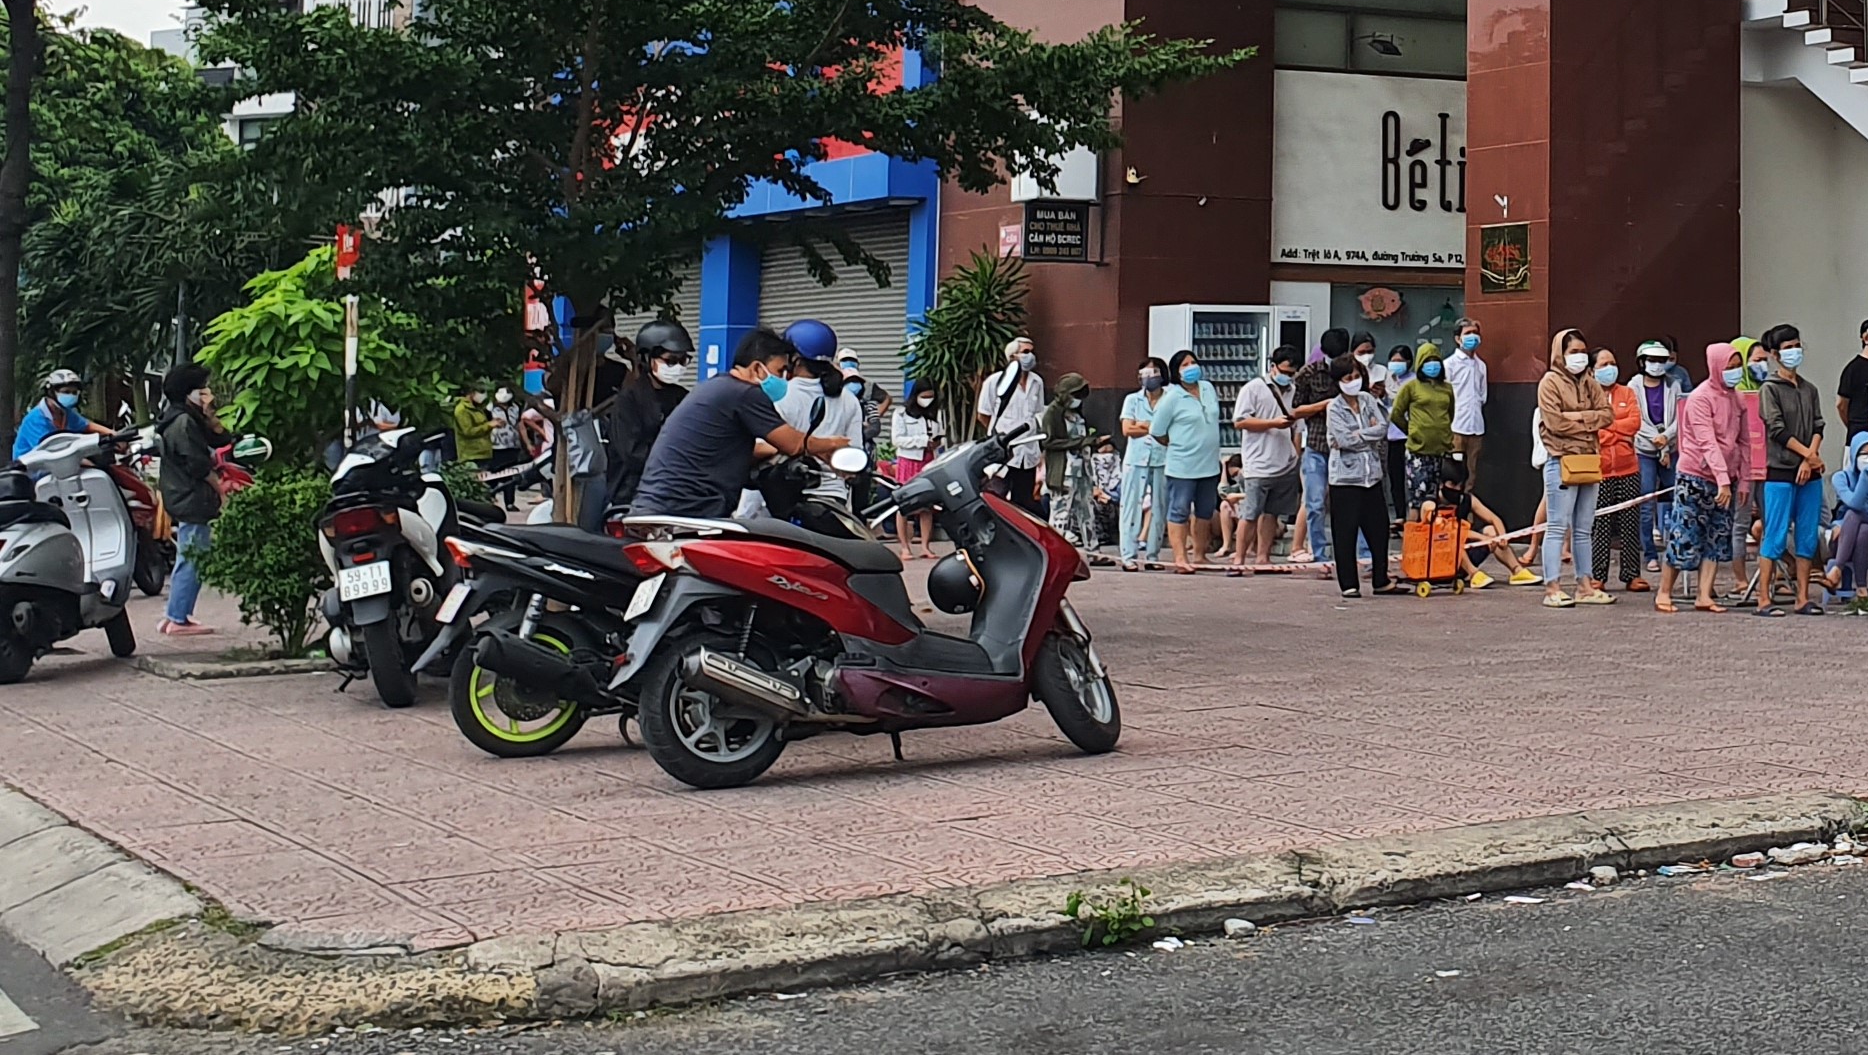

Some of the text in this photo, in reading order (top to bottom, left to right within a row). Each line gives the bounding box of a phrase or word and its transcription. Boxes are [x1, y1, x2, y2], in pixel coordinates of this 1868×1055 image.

[1037, 209, 1076, 219] MUA BÁN
[1281, 248, 1301, 259] Add:
[1303, 249, 1320, 260] Trệt
[1372, 250, 1398, 264] đường
[1401, 251, 1429, 264] Trường
[344, 577, 389, 598] 89999
